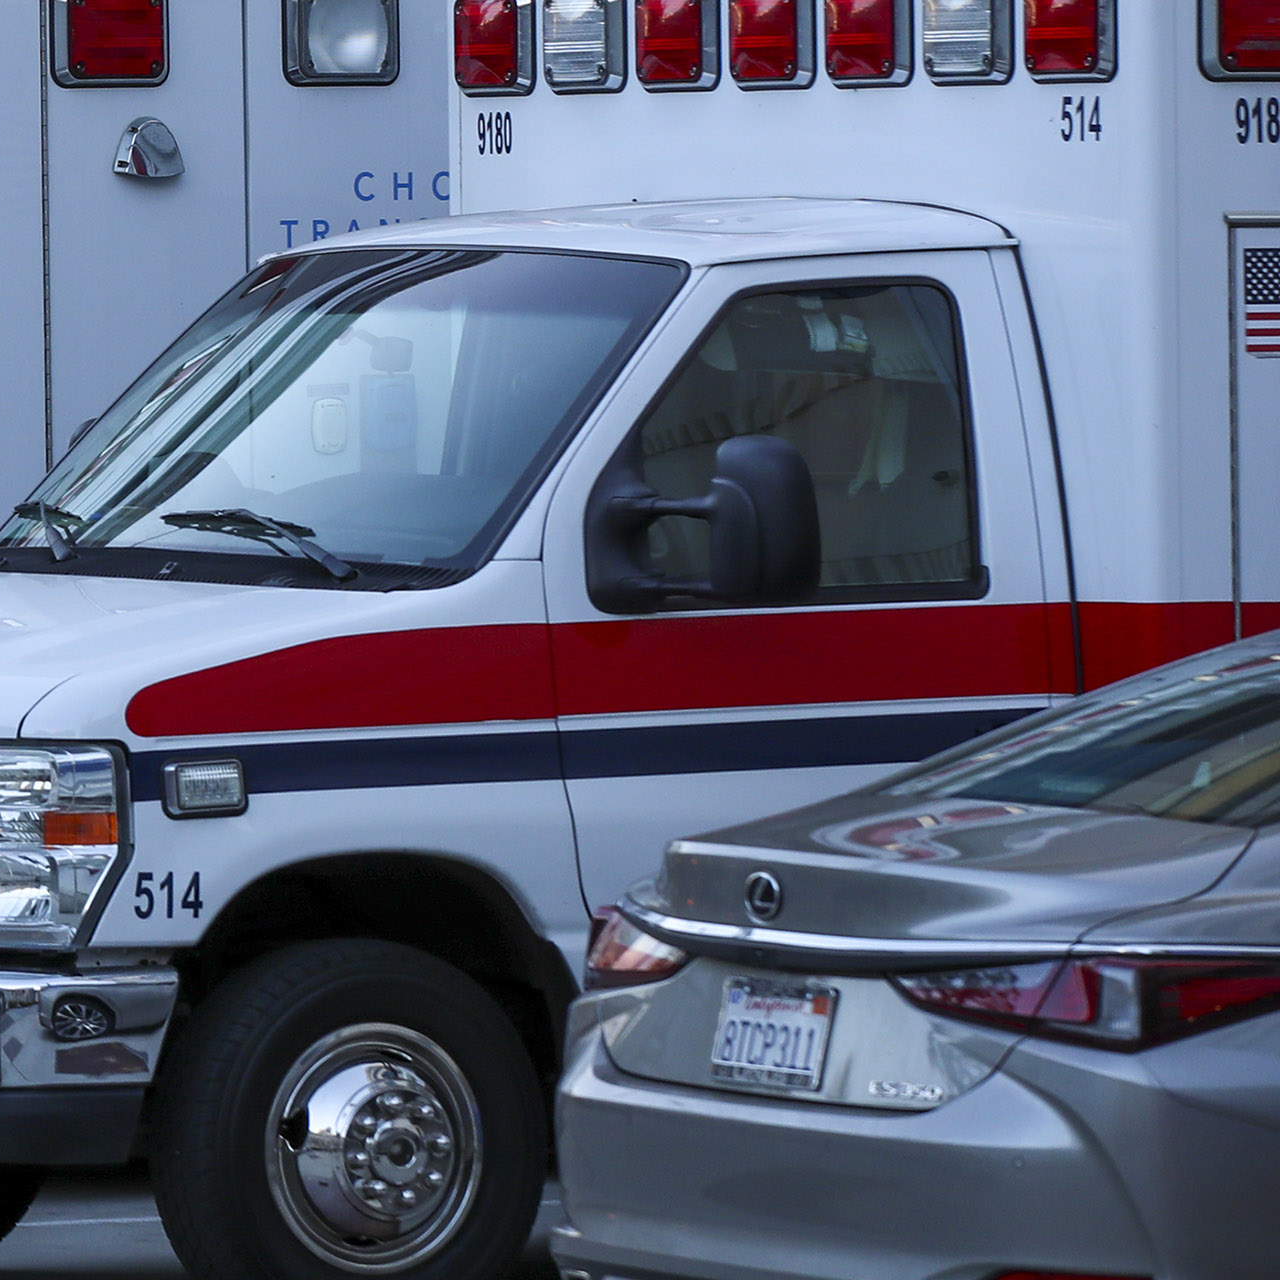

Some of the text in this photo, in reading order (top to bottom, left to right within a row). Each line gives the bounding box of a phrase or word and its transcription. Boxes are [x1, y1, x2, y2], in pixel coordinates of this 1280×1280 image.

[477, 111, 512, 155] 9180
[1061, 95, 1103, 142] 514
[134, 871, 203, 919] 514
[719, 1020, 817, 1071] 8TCP311
